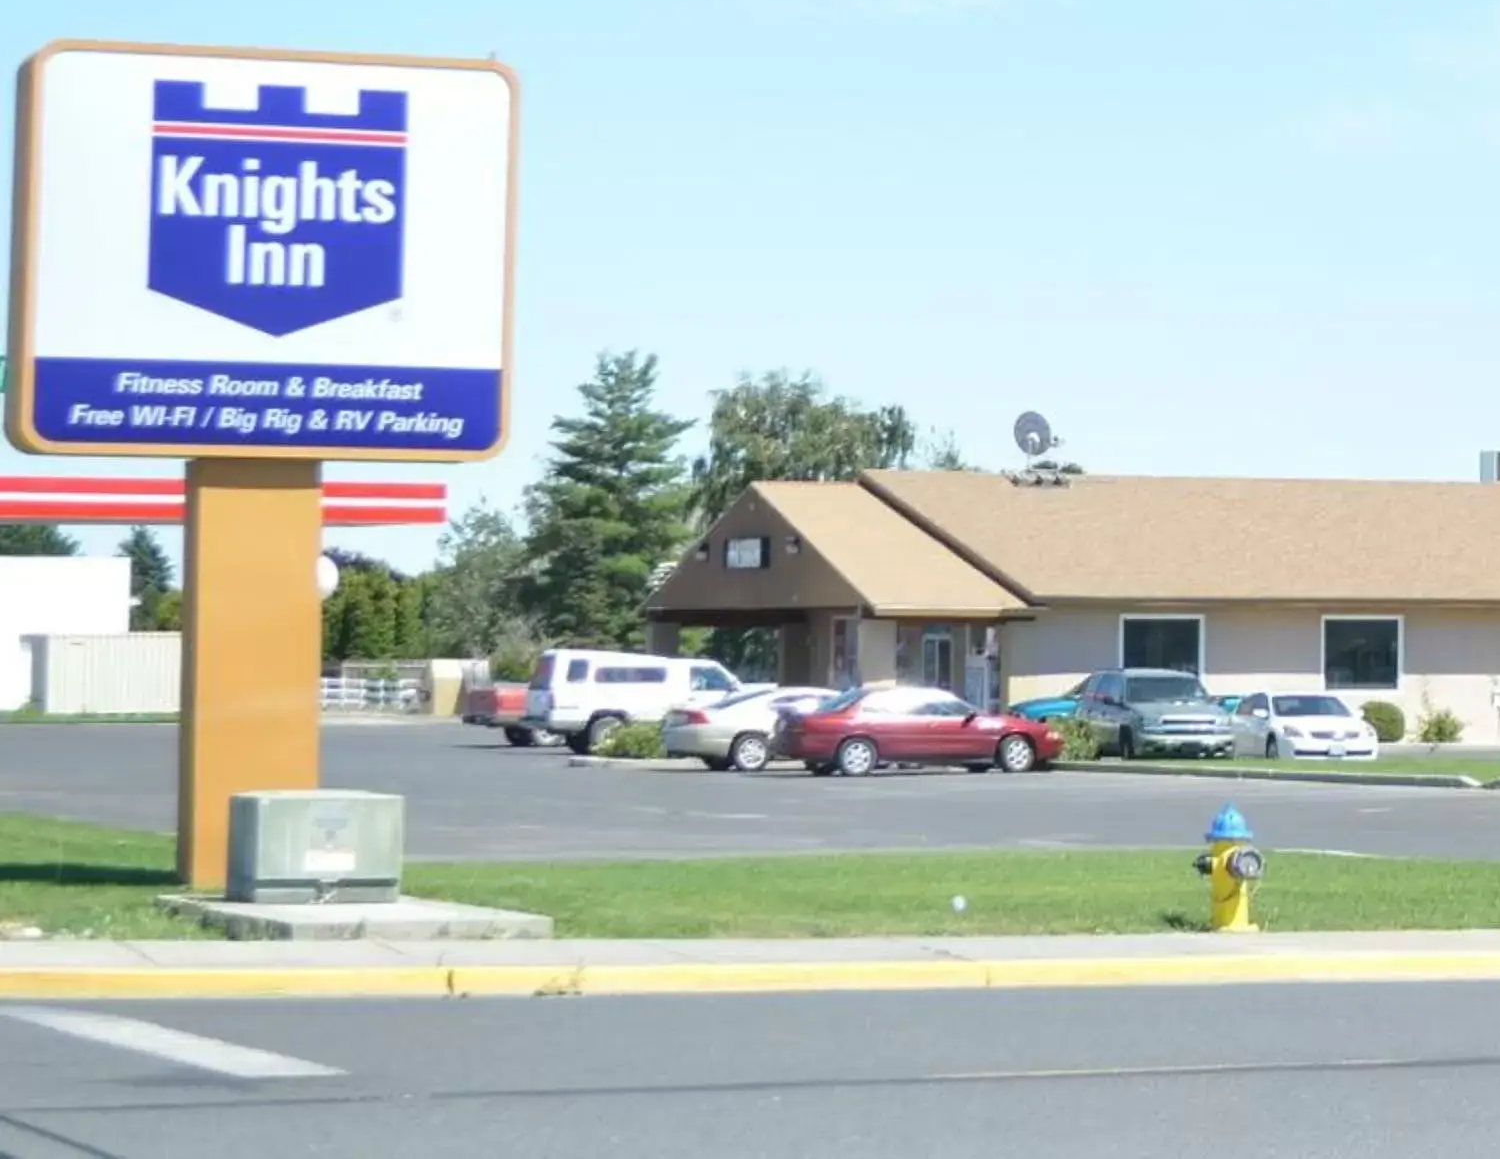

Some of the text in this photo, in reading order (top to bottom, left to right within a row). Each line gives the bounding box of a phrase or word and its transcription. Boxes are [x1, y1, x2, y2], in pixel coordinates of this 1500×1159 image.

[158, 154, 397, 234] Knights
[226, 223, 326, 288] Inn
[115, 372, 423, 401] Fitness Room & Breakfast
[69, 403, 124, 426] Free
[217, 406, 258, 433] Big
[262, 408, 302, 434] Rig
[308, 408, 328, 431] &
[334, 410, 374, 431] RV
[377, 411, 465, 439] Parking
